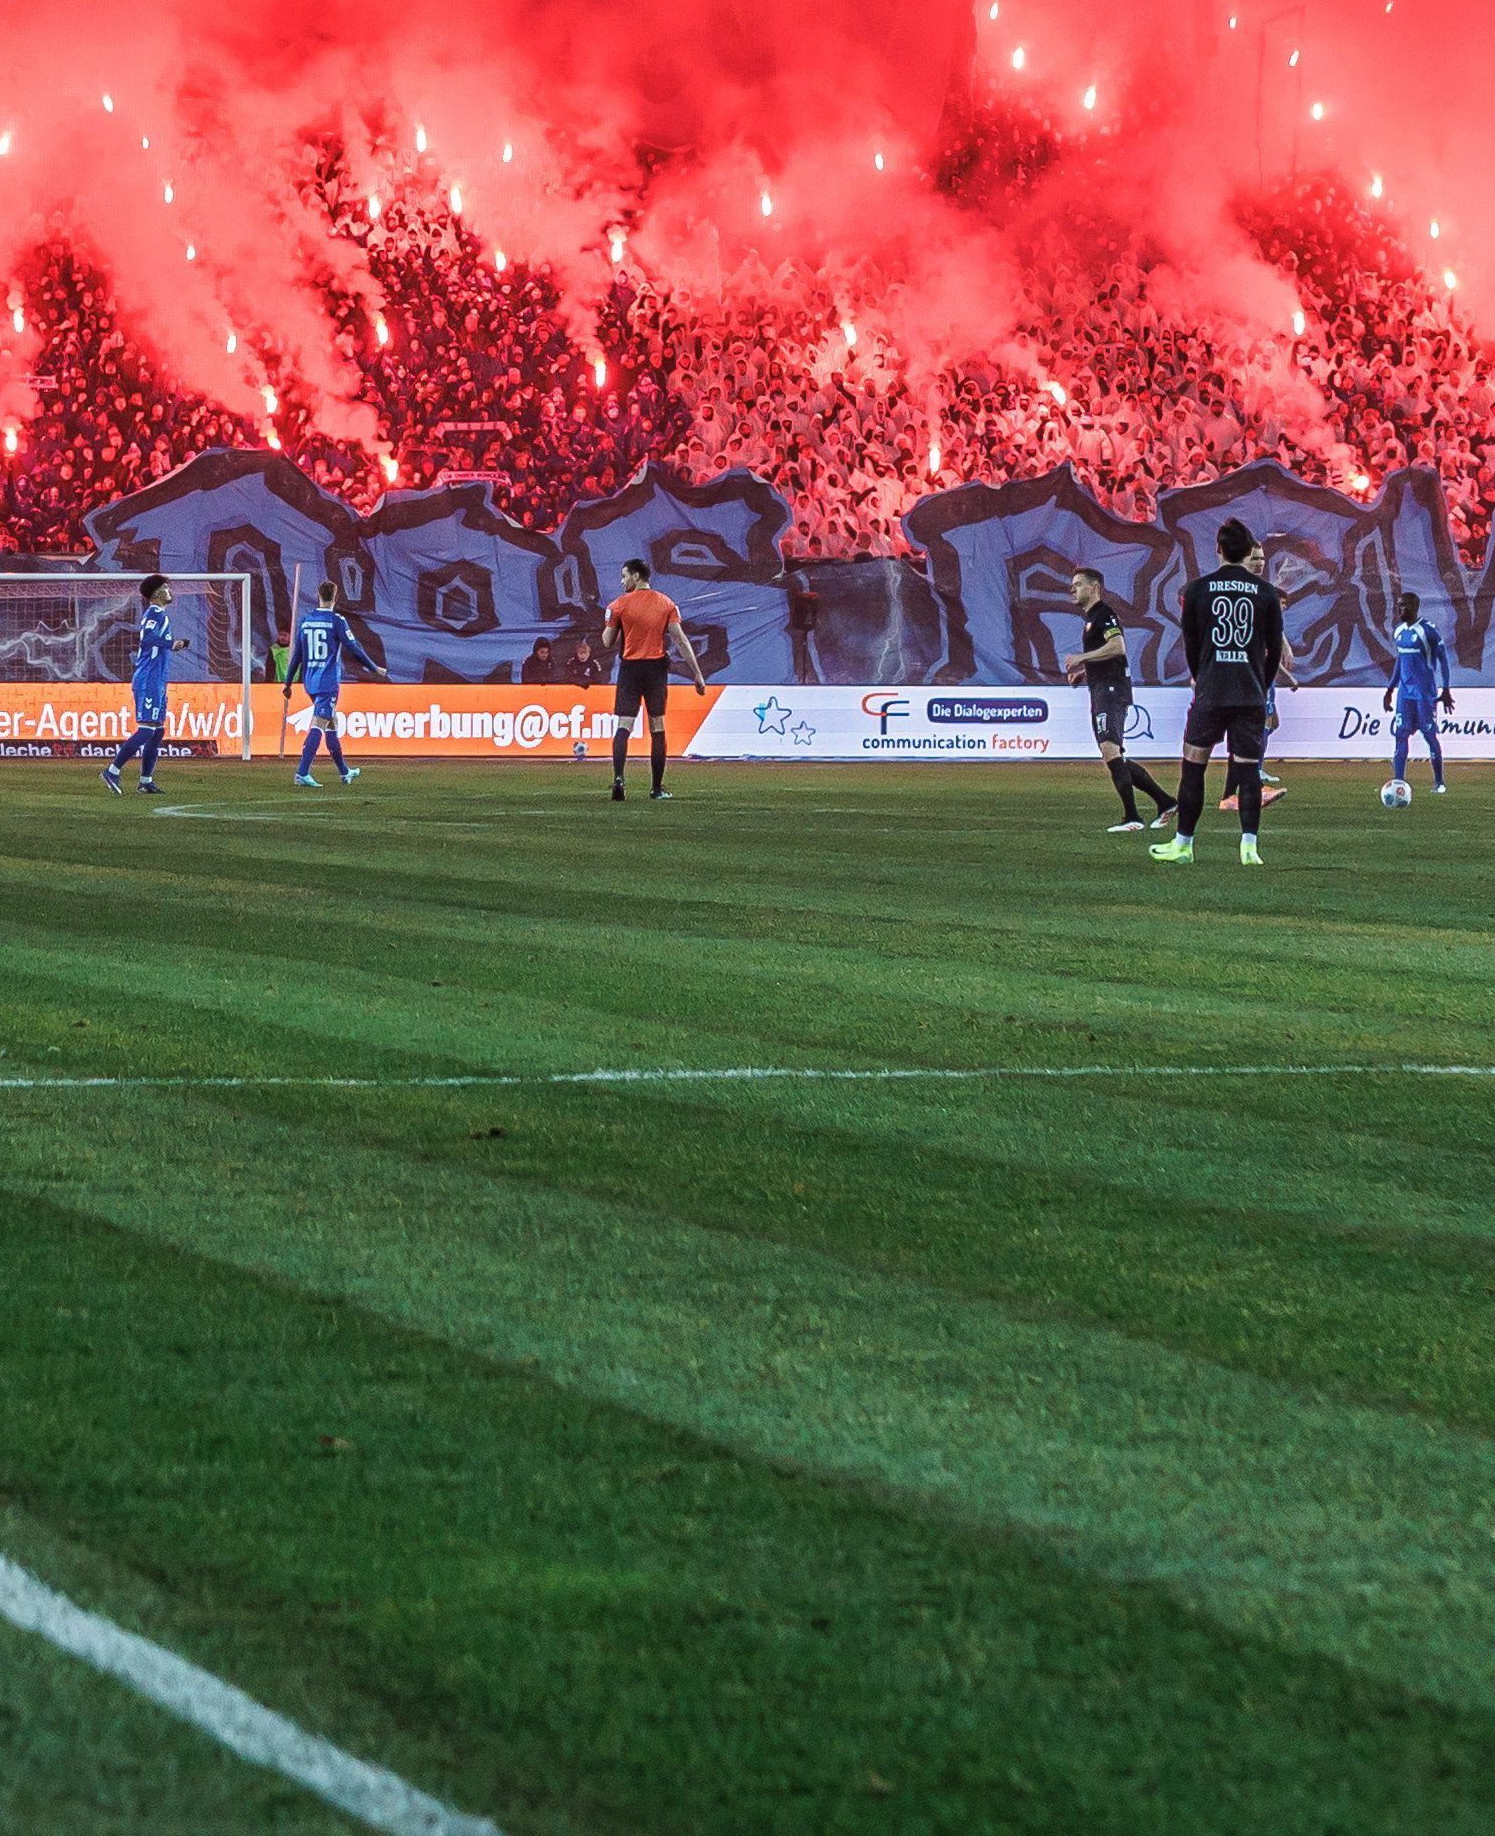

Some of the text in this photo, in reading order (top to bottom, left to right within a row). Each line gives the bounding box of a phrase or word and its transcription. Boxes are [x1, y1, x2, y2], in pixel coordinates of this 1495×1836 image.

[1209, 580, 1259, 595] DRESDEN
[1211, 595, 1255, 648] 39
[303, 628, 329, 660] 16
[1215, 649, 1249, 663] KELLER
[932, 703, 1043, 721] Die Dialogexperten
[1338, 706, 1381, 740] Die
[335, 704, 644, 749] bewerbung@cf.m
[862, 733, 1050, 753] communication factory
